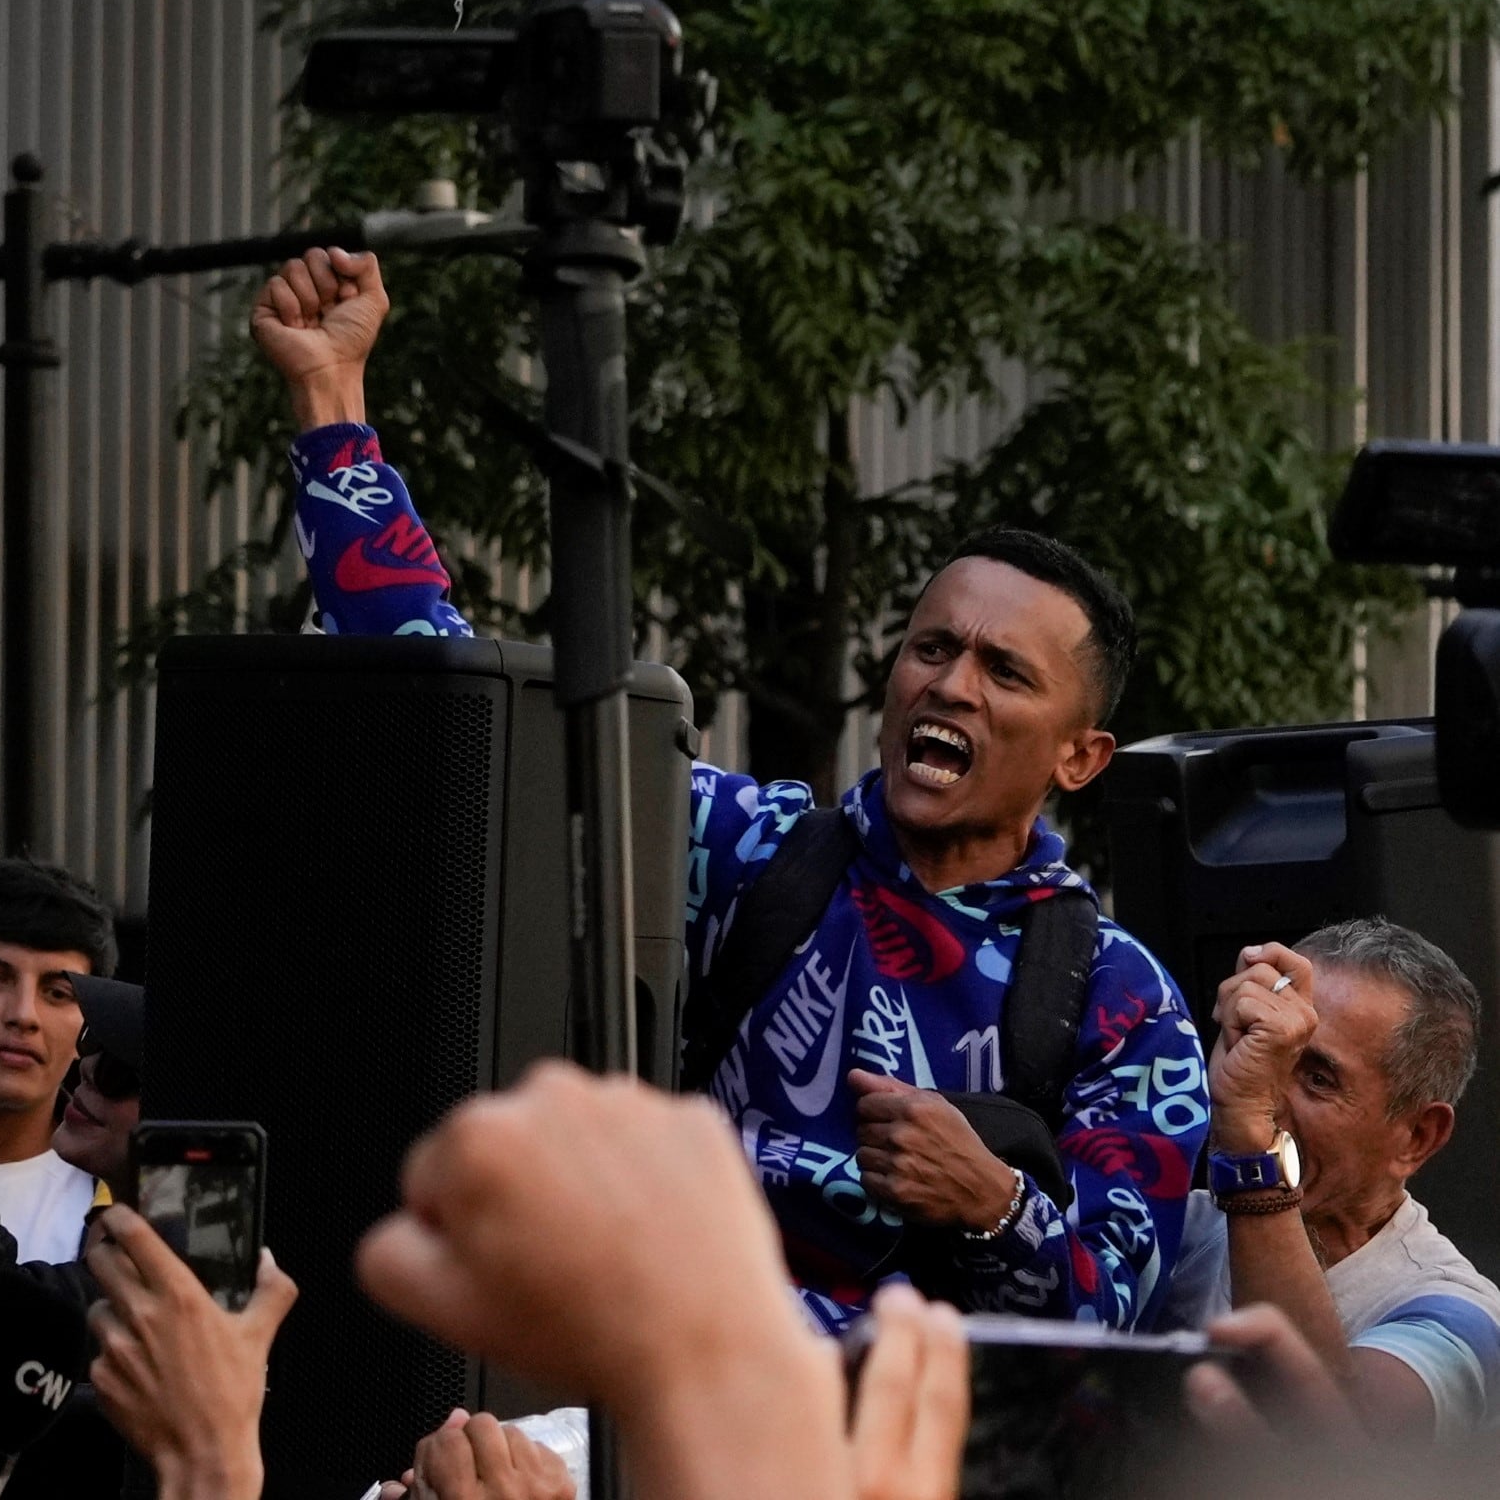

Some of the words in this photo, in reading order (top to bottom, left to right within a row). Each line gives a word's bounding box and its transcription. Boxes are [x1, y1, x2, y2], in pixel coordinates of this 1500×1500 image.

[762, 950, 843, 1077] NIKE
[851, 985, 907, 1078] ike
[15, 1360, 72, 1411] CNN
